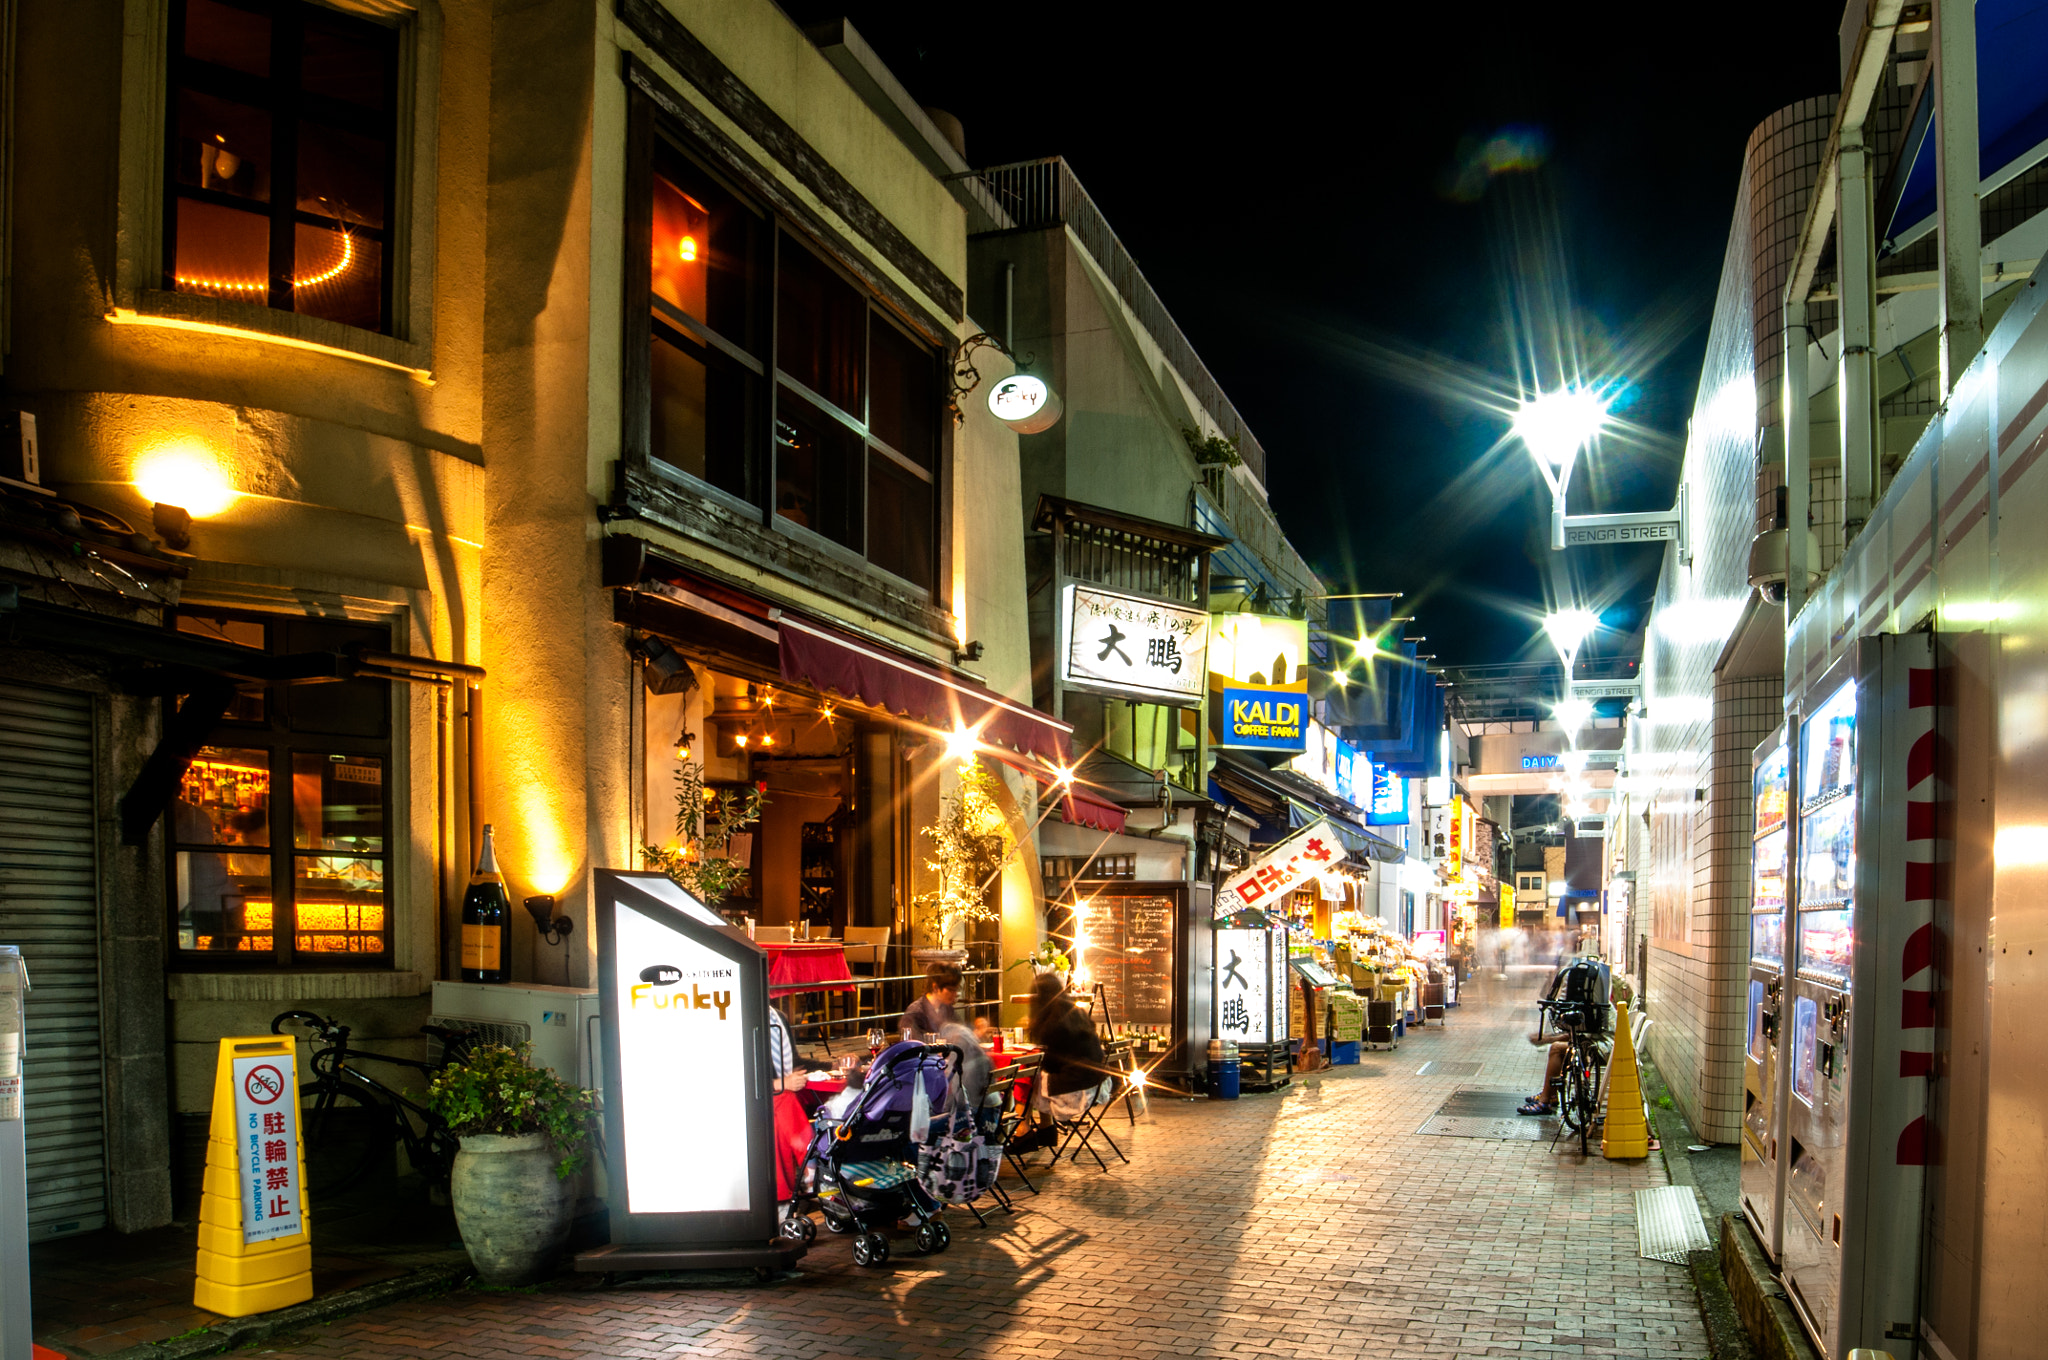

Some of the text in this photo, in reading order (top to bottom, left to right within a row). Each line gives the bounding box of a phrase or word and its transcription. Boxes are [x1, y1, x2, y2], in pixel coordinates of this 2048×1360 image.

[997, 391, 1037, 406] Fuky
[1568, 525, 1677, 542] RENGA STREET
[1096, 623, 1183, 675] 大鵬
[1573, 687, 1639, 696] RENGA STREET
[1233, 699, 1300, 727] KALDI
[1233, 723, 1300, 738] COFFEE FARM
[630, 983, 732, 1021] Funky
[1221, 948, 1250, 1035] 大鵬
[248, 1112, 264, 1222] NO BICYCLE PARKING
[263, 1111, 291, 1219] 駐輪禁止
